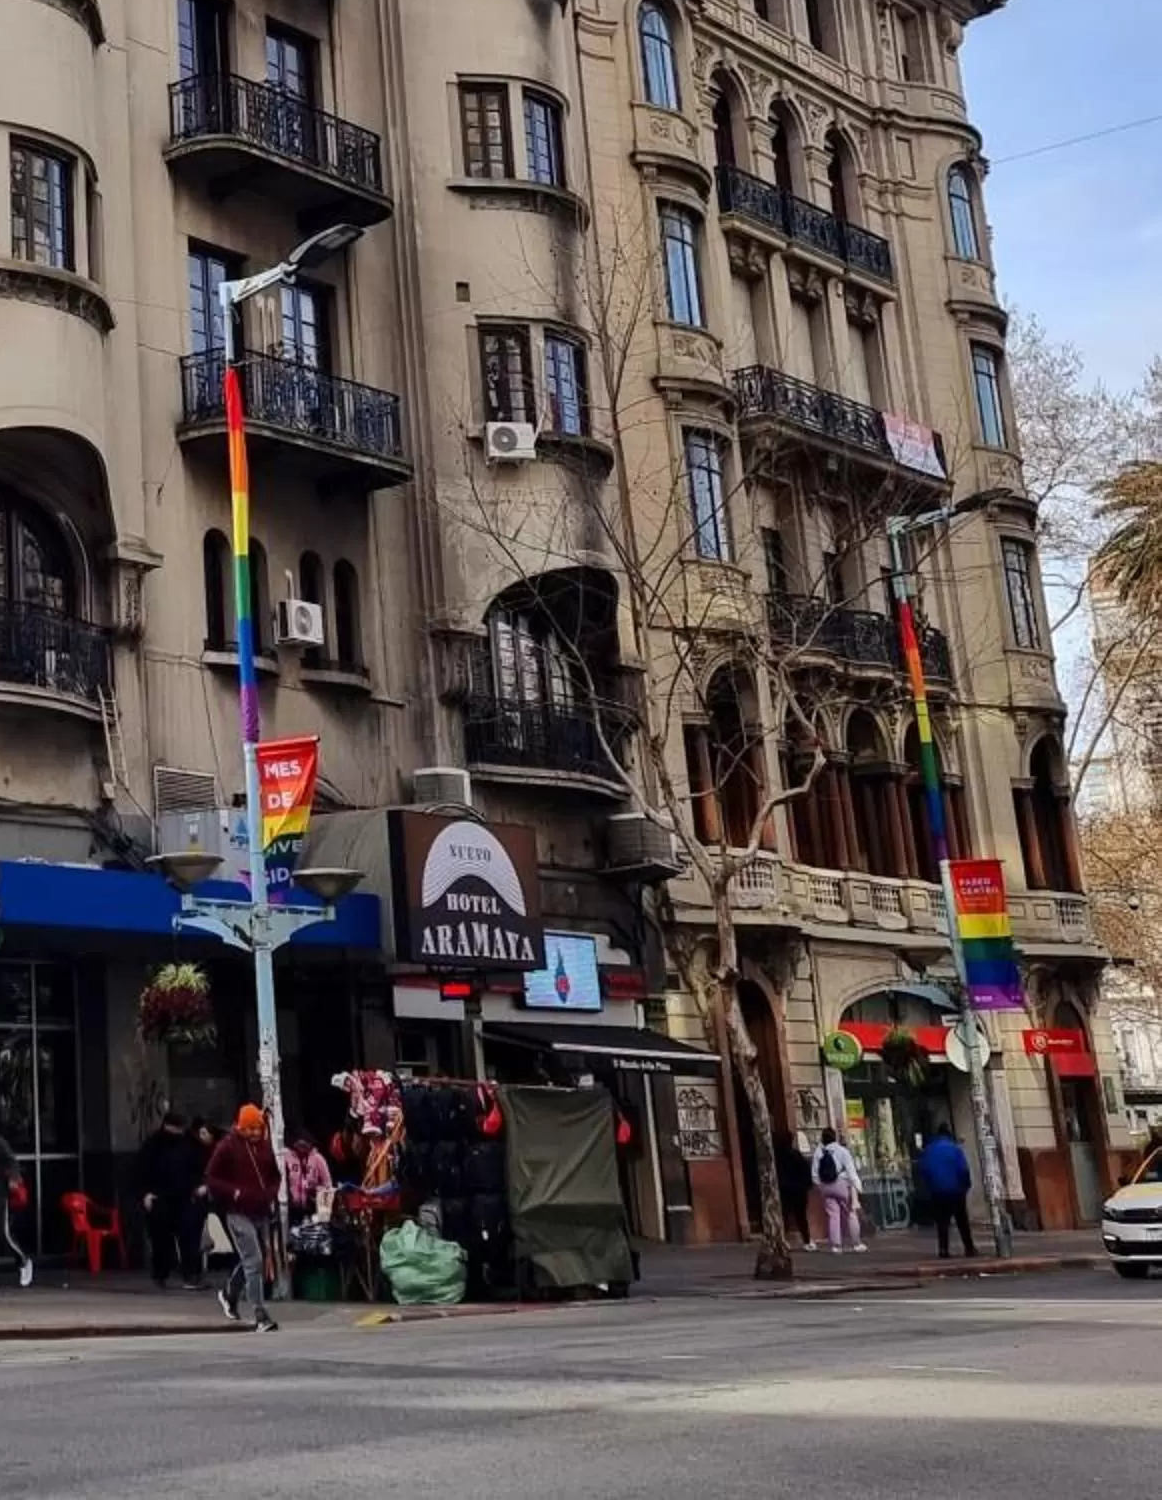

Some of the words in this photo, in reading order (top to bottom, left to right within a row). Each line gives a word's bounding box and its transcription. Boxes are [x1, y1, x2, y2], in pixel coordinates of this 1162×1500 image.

[264, 759, 302, 779] MES
[268, 792, 294, 810] DE
[450, 843, 492, 863] NUEVO
[446, 893, 502, 915] HOTEL
[421, 921, 536, 961] ARAMAYA
